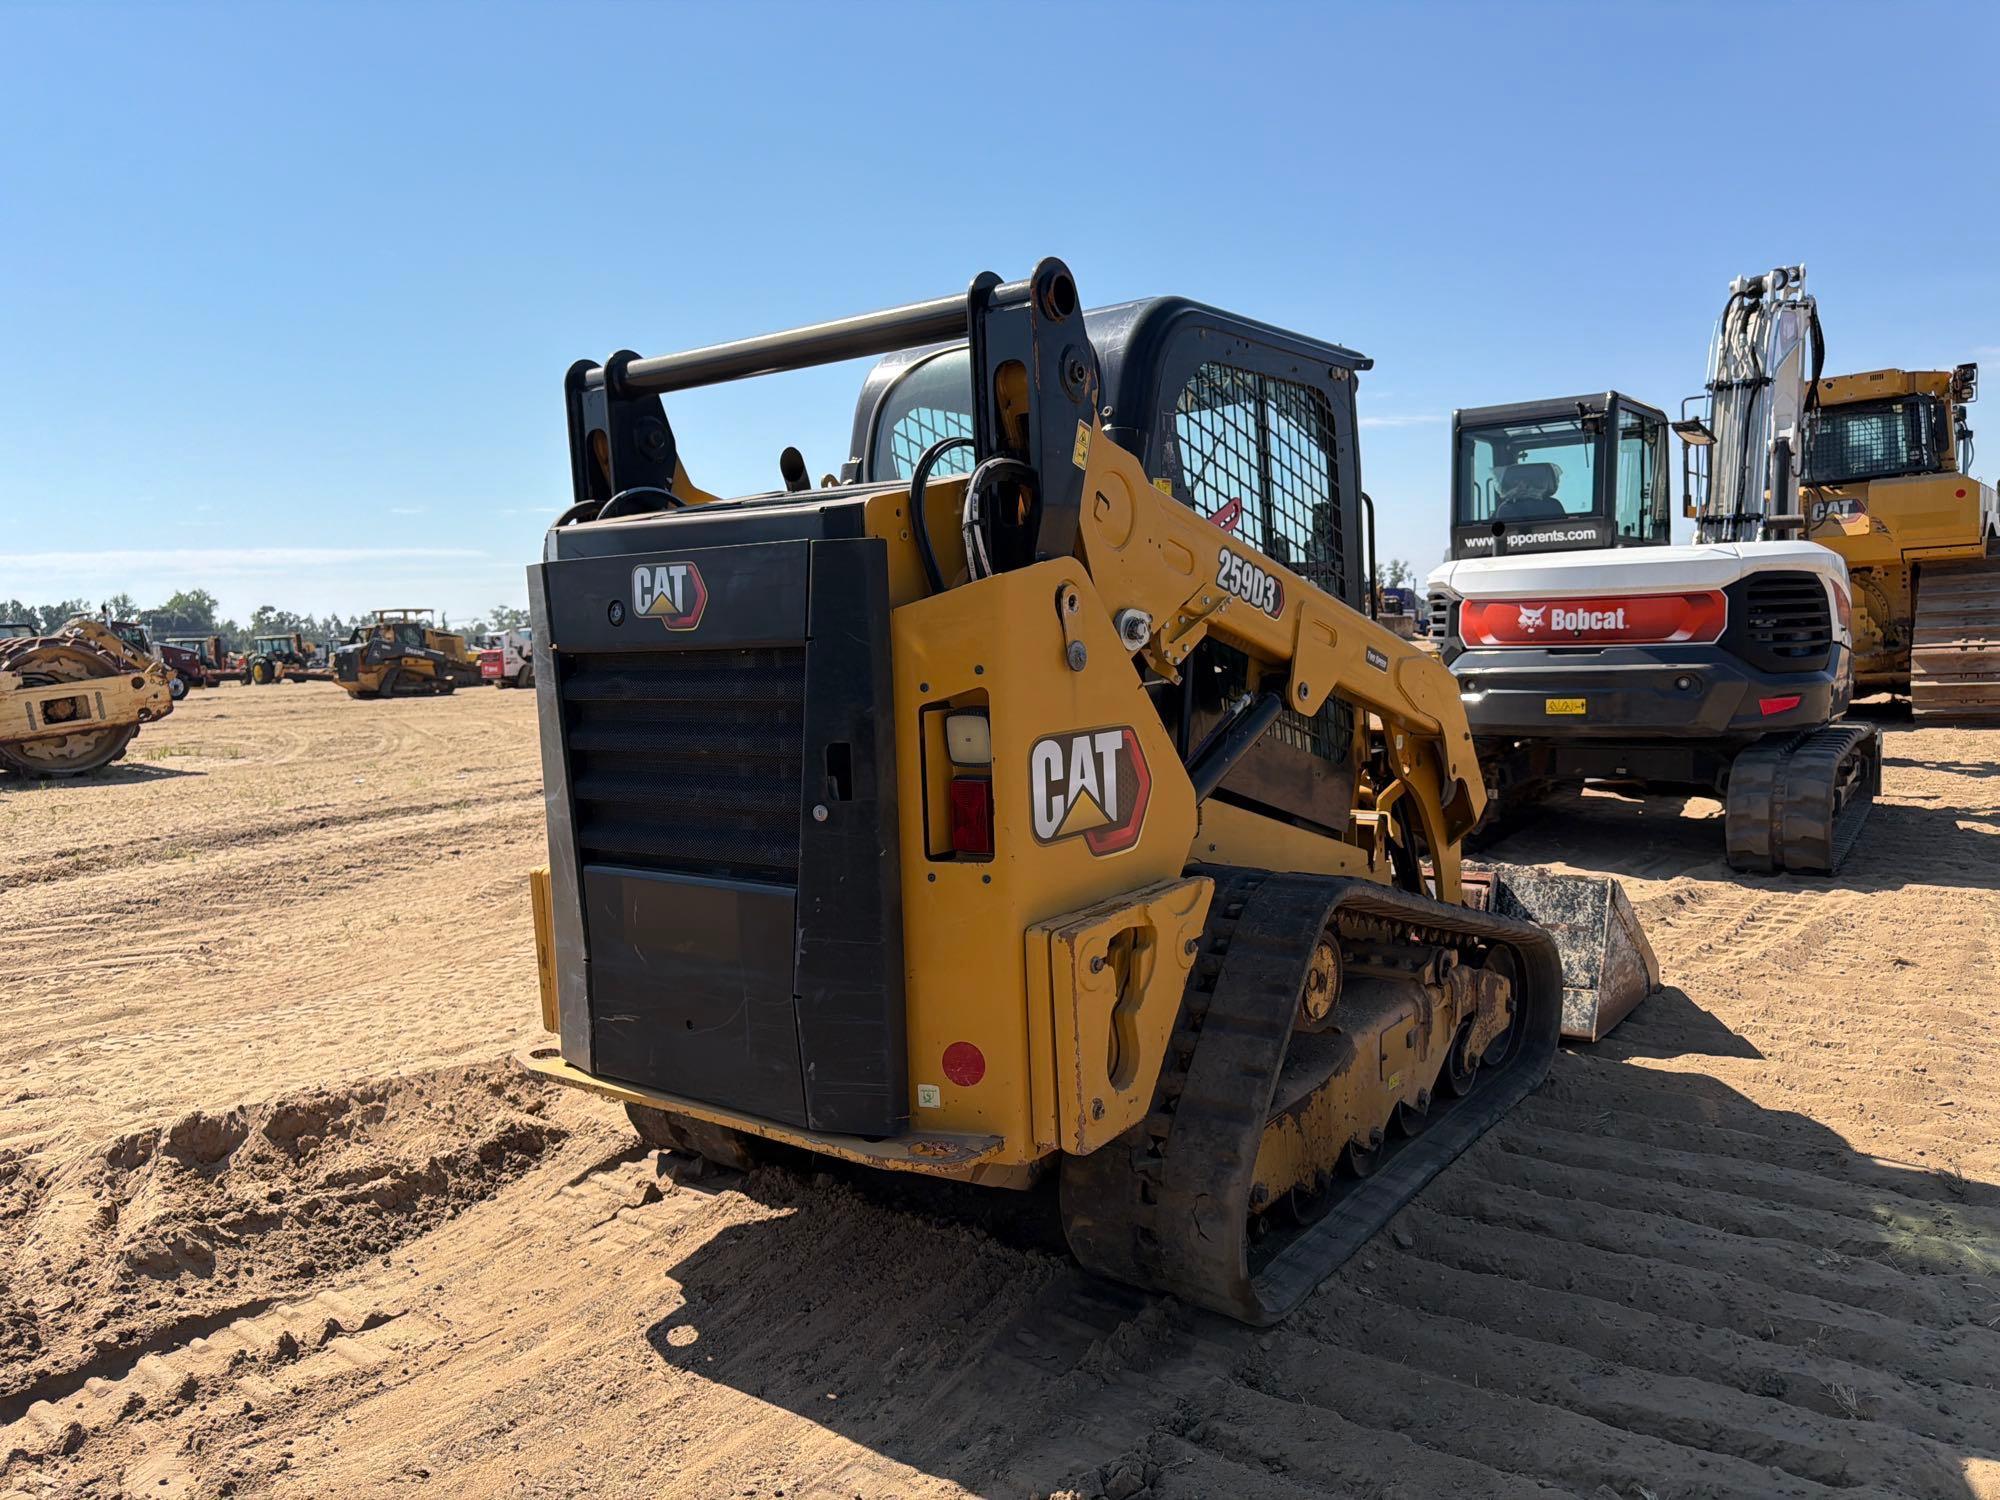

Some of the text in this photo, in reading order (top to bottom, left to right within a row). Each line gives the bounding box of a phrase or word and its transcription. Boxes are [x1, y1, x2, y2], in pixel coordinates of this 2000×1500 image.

[1812, 500, 1853, 521] CAT
[1465, 529, 1597, 548] wwwpporents.com
[634, 565, 687, 615] CAT
[1217, 549, 1276, 613] 259D3
[1551, 608, 1625, 630] Bobcat
[1032, 730, 1123, 839] CAT
